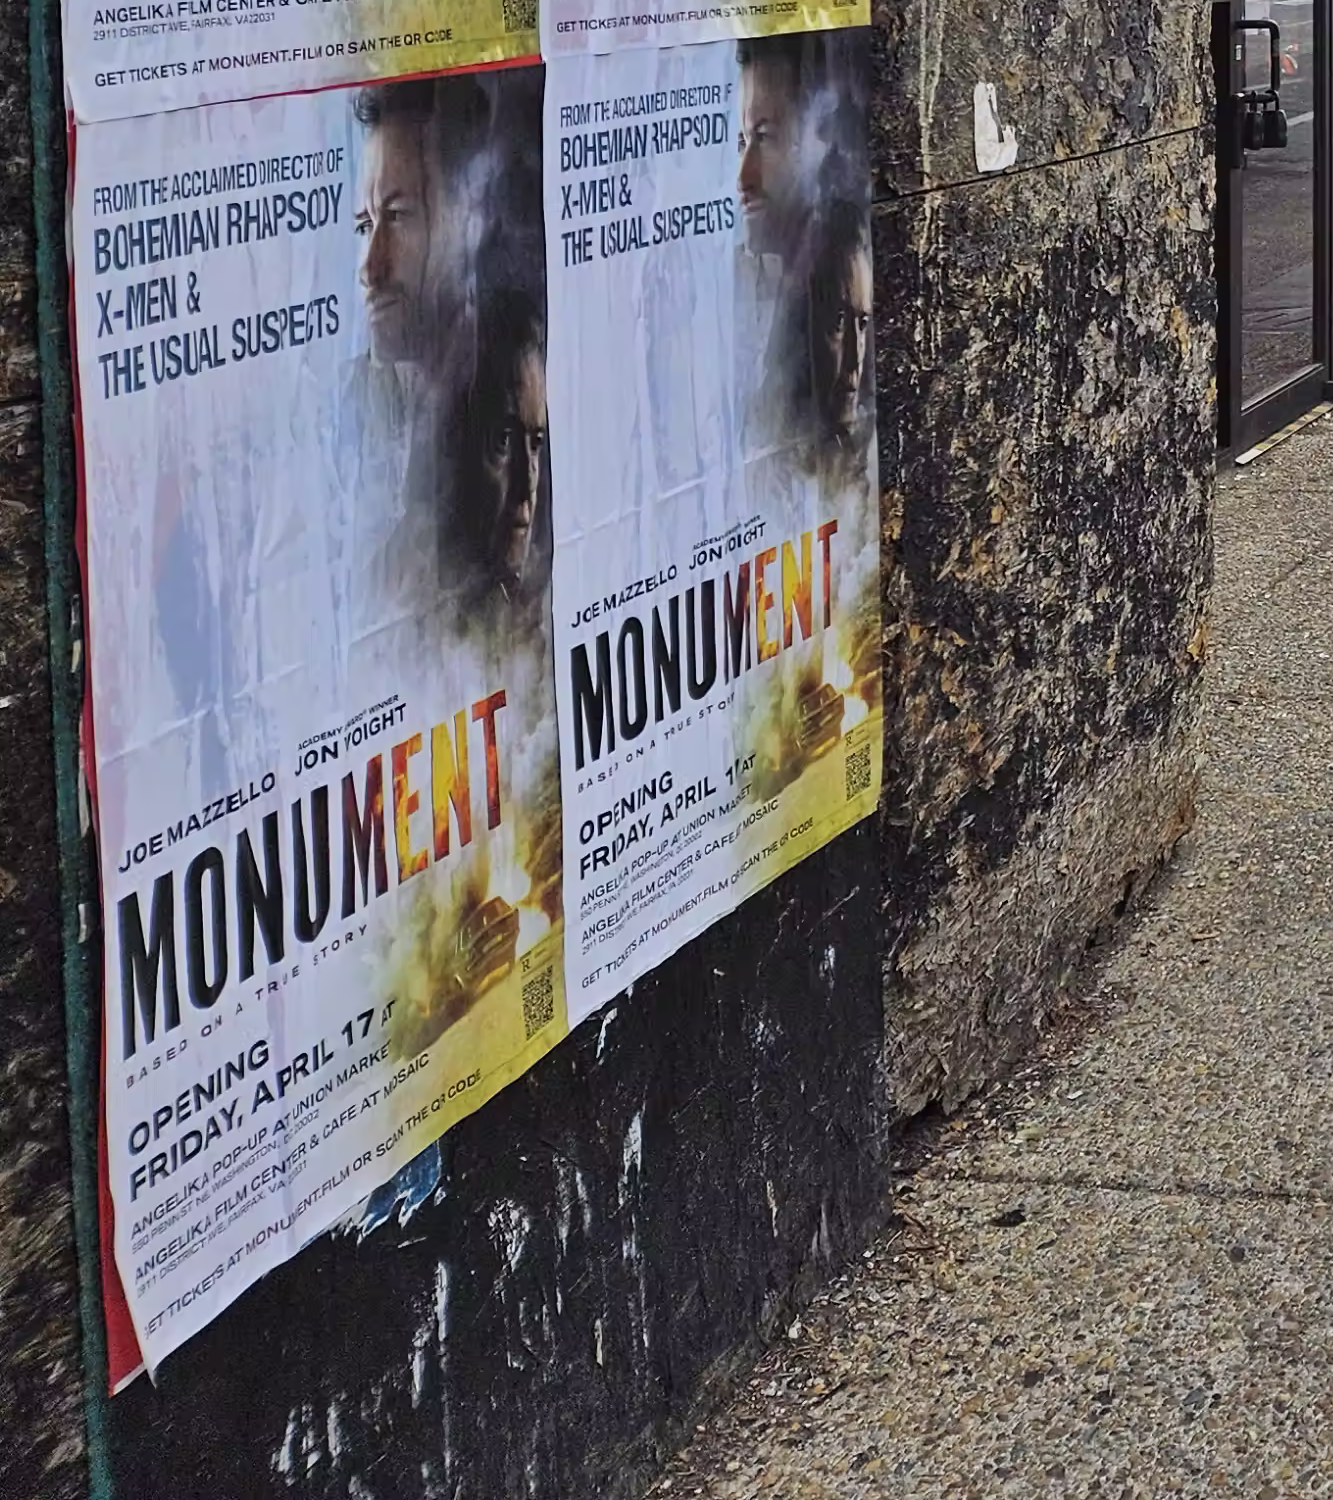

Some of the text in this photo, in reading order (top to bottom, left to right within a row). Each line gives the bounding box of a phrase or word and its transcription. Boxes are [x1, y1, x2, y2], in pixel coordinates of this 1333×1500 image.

[93, 4, 173, 26] ANGELIKA
[556, 21, 577, 33] GET
[94, 33, 421, 87] GET TICKETS AT OR THE QR
[560, 103, 590, 128] FROM
[94, 147, 344, 216] FROM THE ACCLAIMED OF
[619, 173, 632, 206] &
[94, 182, 343, 275] BOHEMIAN RHAPSODY
[561, 197, 734, 268] THE USUAL SUSPECTS
[96, 271, 201, 338] X-MEN &
[98, 294, 340, 400] THE USUAL SUSPECTS
[603, 564, 678, 613] MAZZELLO
[689, 545, 723, 571] JON
[569, 518, 838, 771] MONUMENT
[295, 741, 338, 776] JON
[298, 726, 343, 750] ACADEMY
[118, 772, 275, 873] JOE MAZZELLO
[579, 771, 673, 846] OPENING
[580, 775, 717, 881] FRIDAY, APRIL
[682, 809, 715, 838] UNION
[117, 690, 507, 1061] MONUMENT
[126, 924, 367, 1089] BASED STORY
[128, 1039, 269, 1156] OPENING
[129, 1000, 396, 1203] FRIDAY, APRIL 17 AT
[130, 1078, 333, 1240] ANGELIKA POP-UP UNION
[352, 1107, 428, 1172] OR SCAN THE
[135, 1090, 380, 1285] ANGELIKA FILM CENTER & CAFE AT
